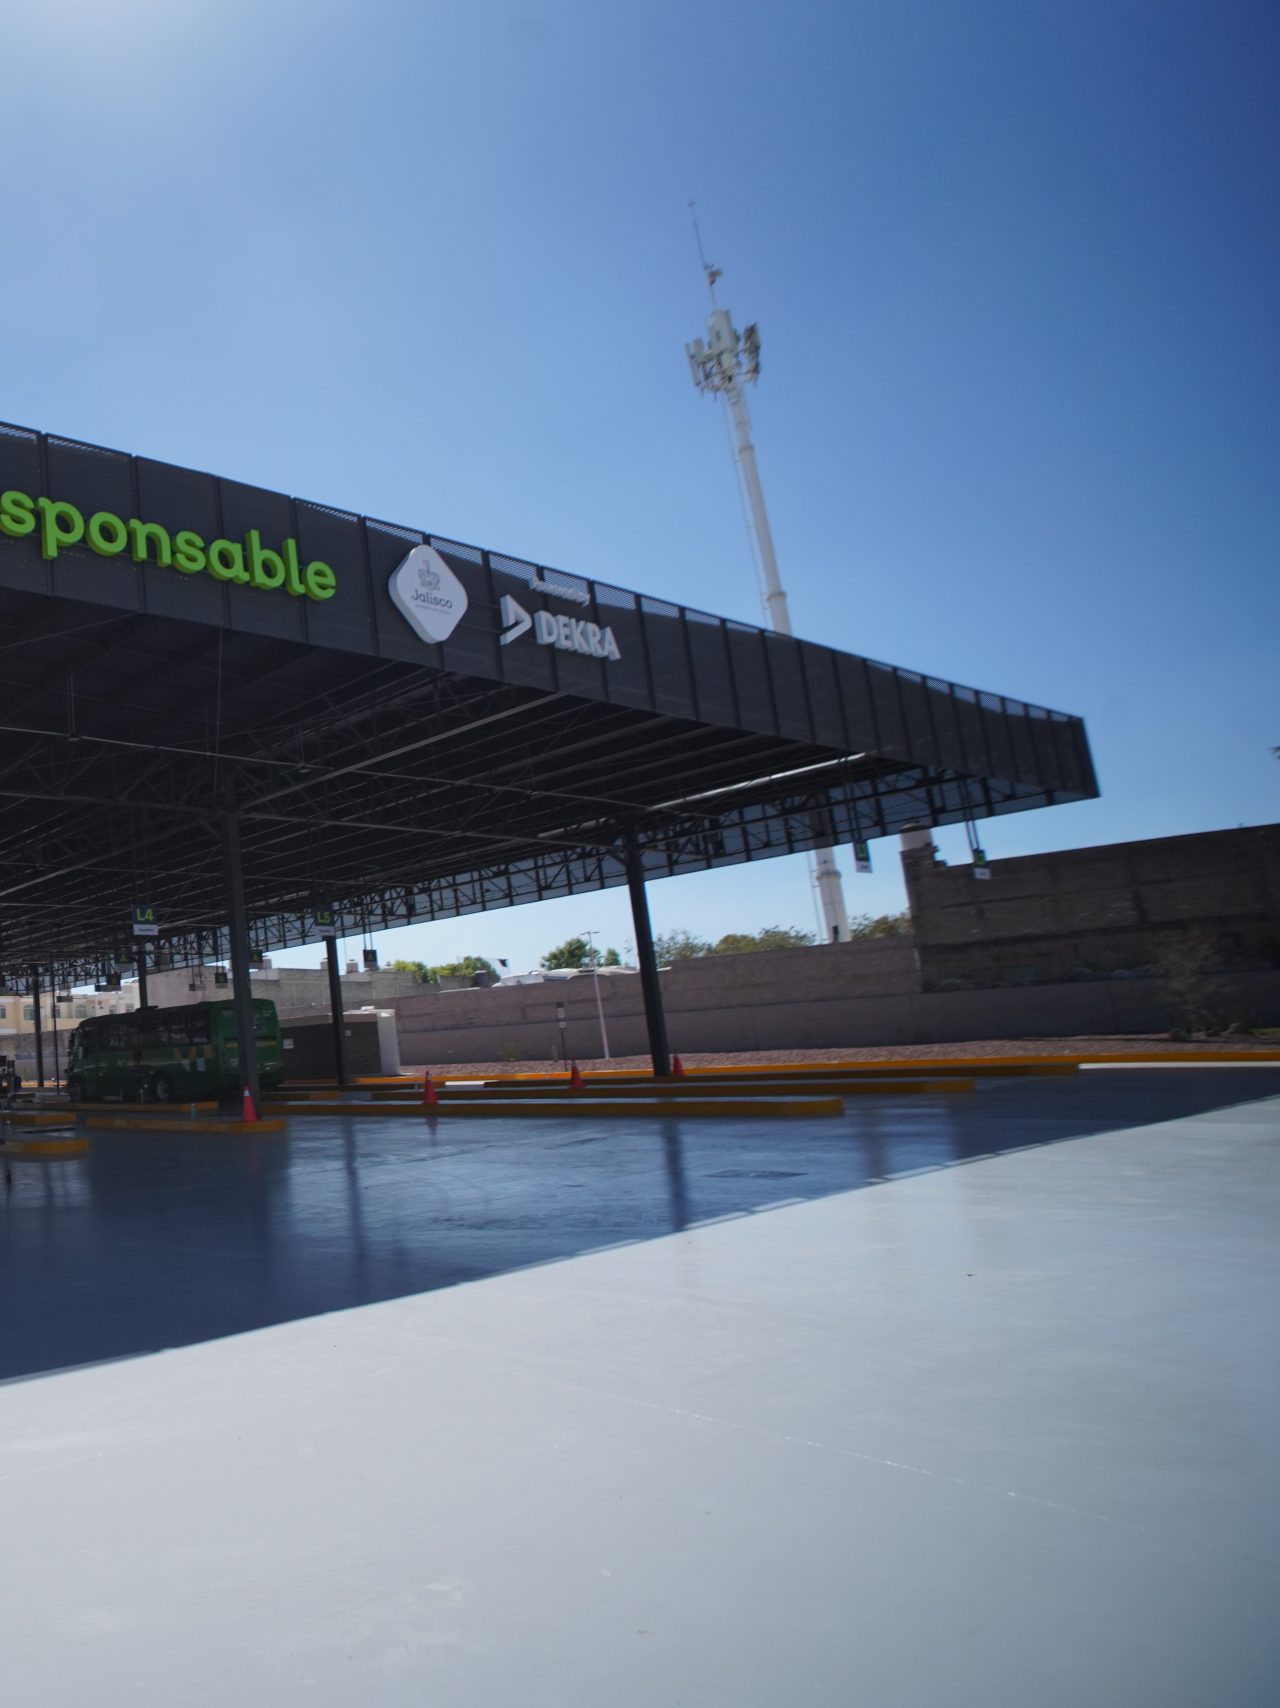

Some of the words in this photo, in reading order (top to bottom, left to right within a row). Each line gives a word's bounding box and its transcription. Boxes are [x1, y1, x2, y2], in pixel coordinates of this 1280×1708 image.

[411, 588, 453, 609] Jalisco
[533, 609, 622, 662] DEKRA
[136, 908, 154, 922] L4
